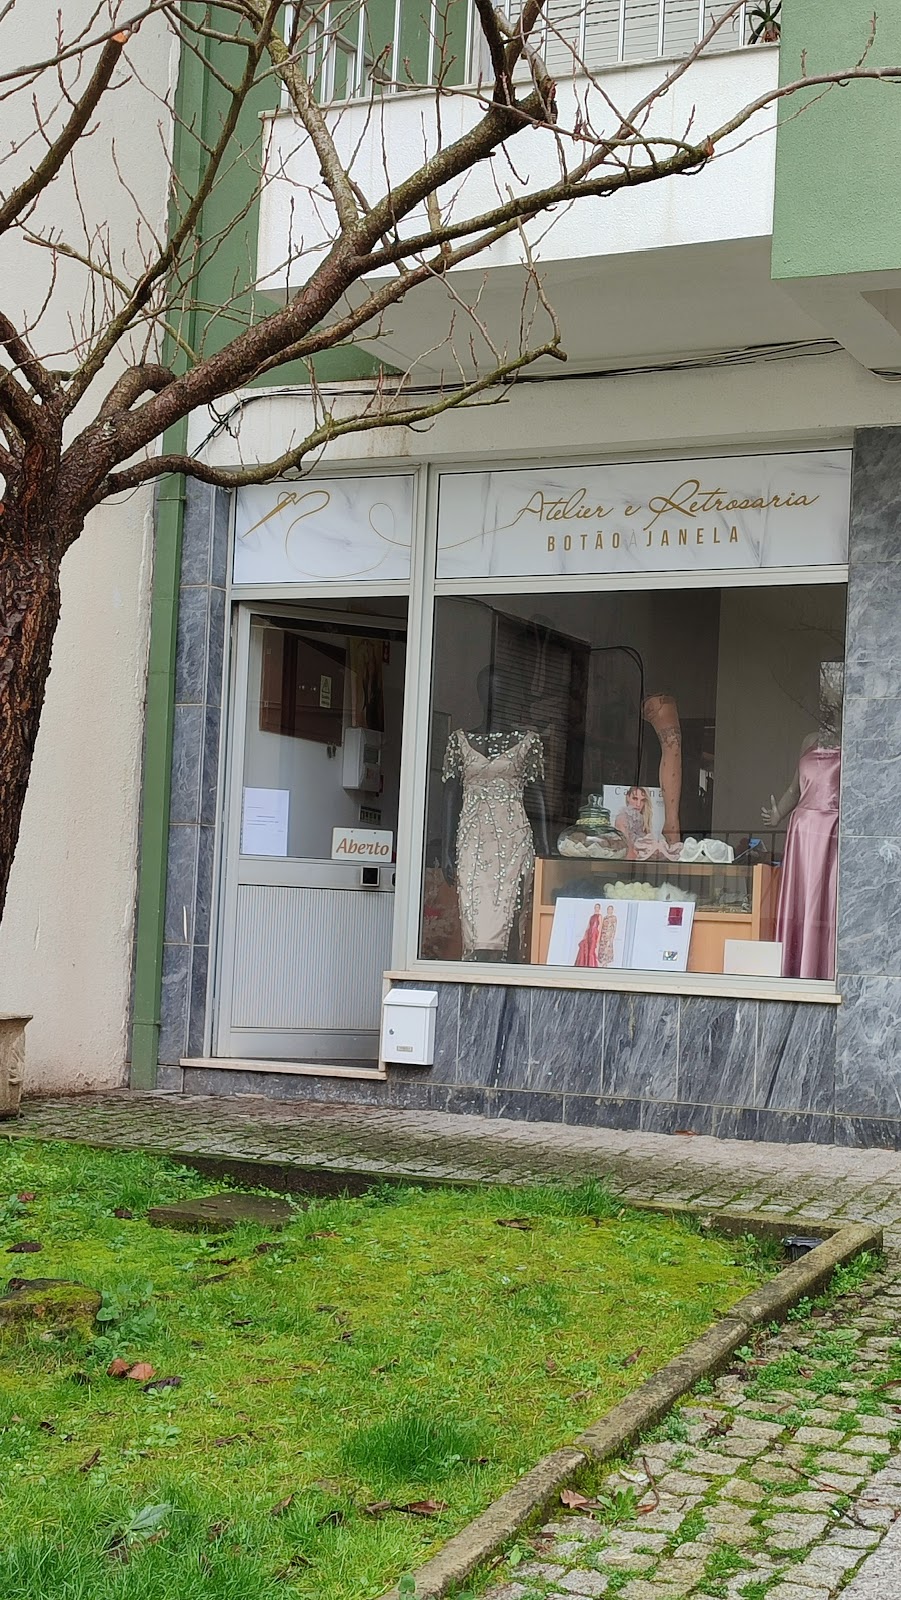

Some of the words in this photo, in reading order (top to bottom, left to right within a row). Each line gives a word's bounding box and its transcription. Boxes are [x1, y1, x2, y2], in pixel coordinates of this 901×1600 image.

[513, 487, 614, 522] Atelier
[624, 505, 642, 517] e
[643, 478, 820, 531] Retrosaria
[547, 530, 621, 552] BOTÃO
[645, 525, 739, 547] JANELA
[335, 837, 390, 856] Aberto
